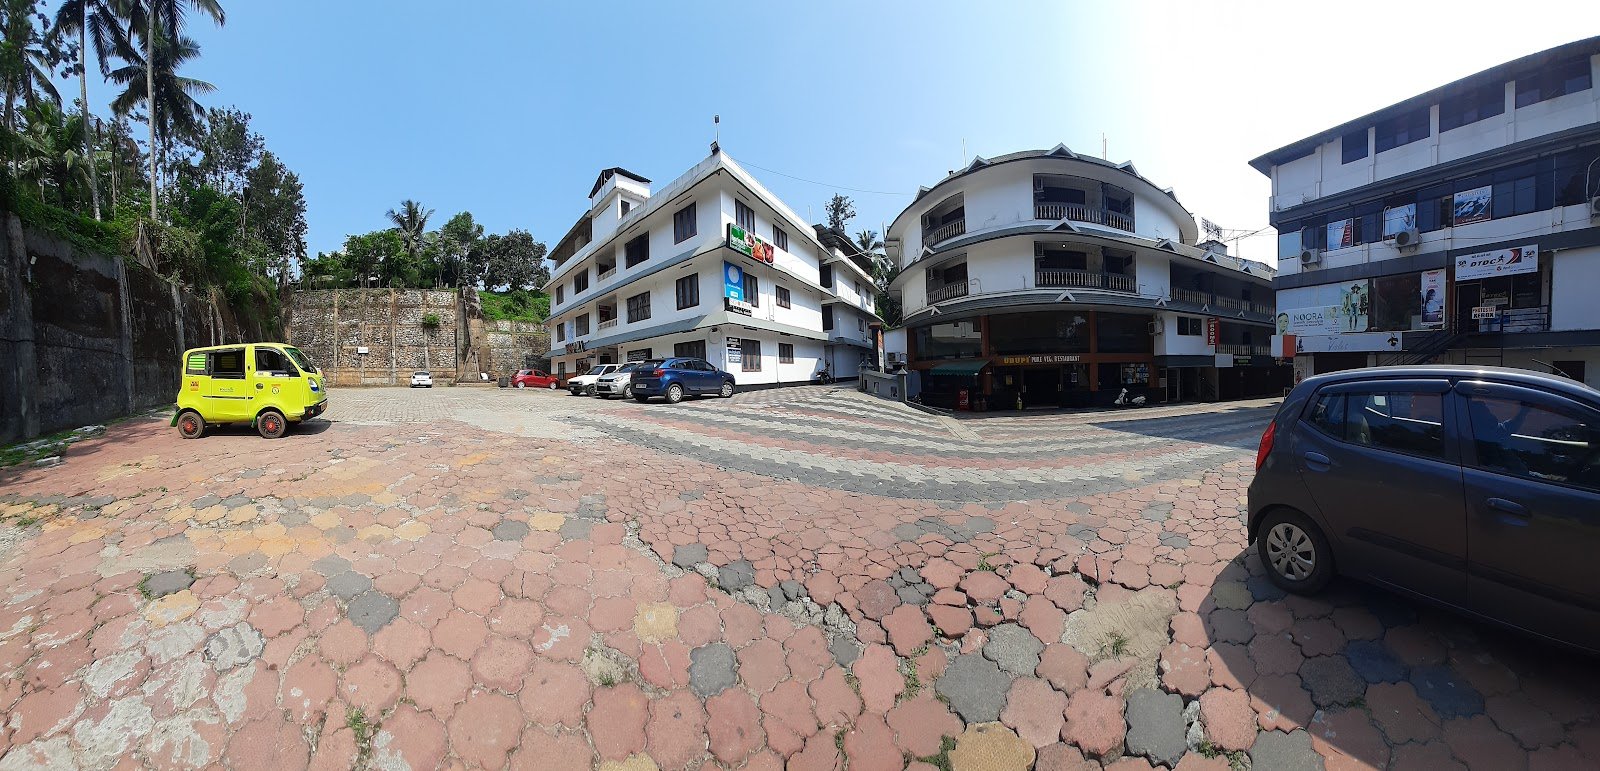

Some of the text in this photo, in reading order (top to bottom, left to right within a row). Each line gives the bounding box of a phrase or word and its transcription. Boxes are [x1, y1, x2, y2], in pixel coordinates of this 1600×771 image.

[1470, 258, 1496, 267] DTDC
[1293, 312, 1323, 321] NOORA
[1003, 356, 1029, 364] UDUPI
